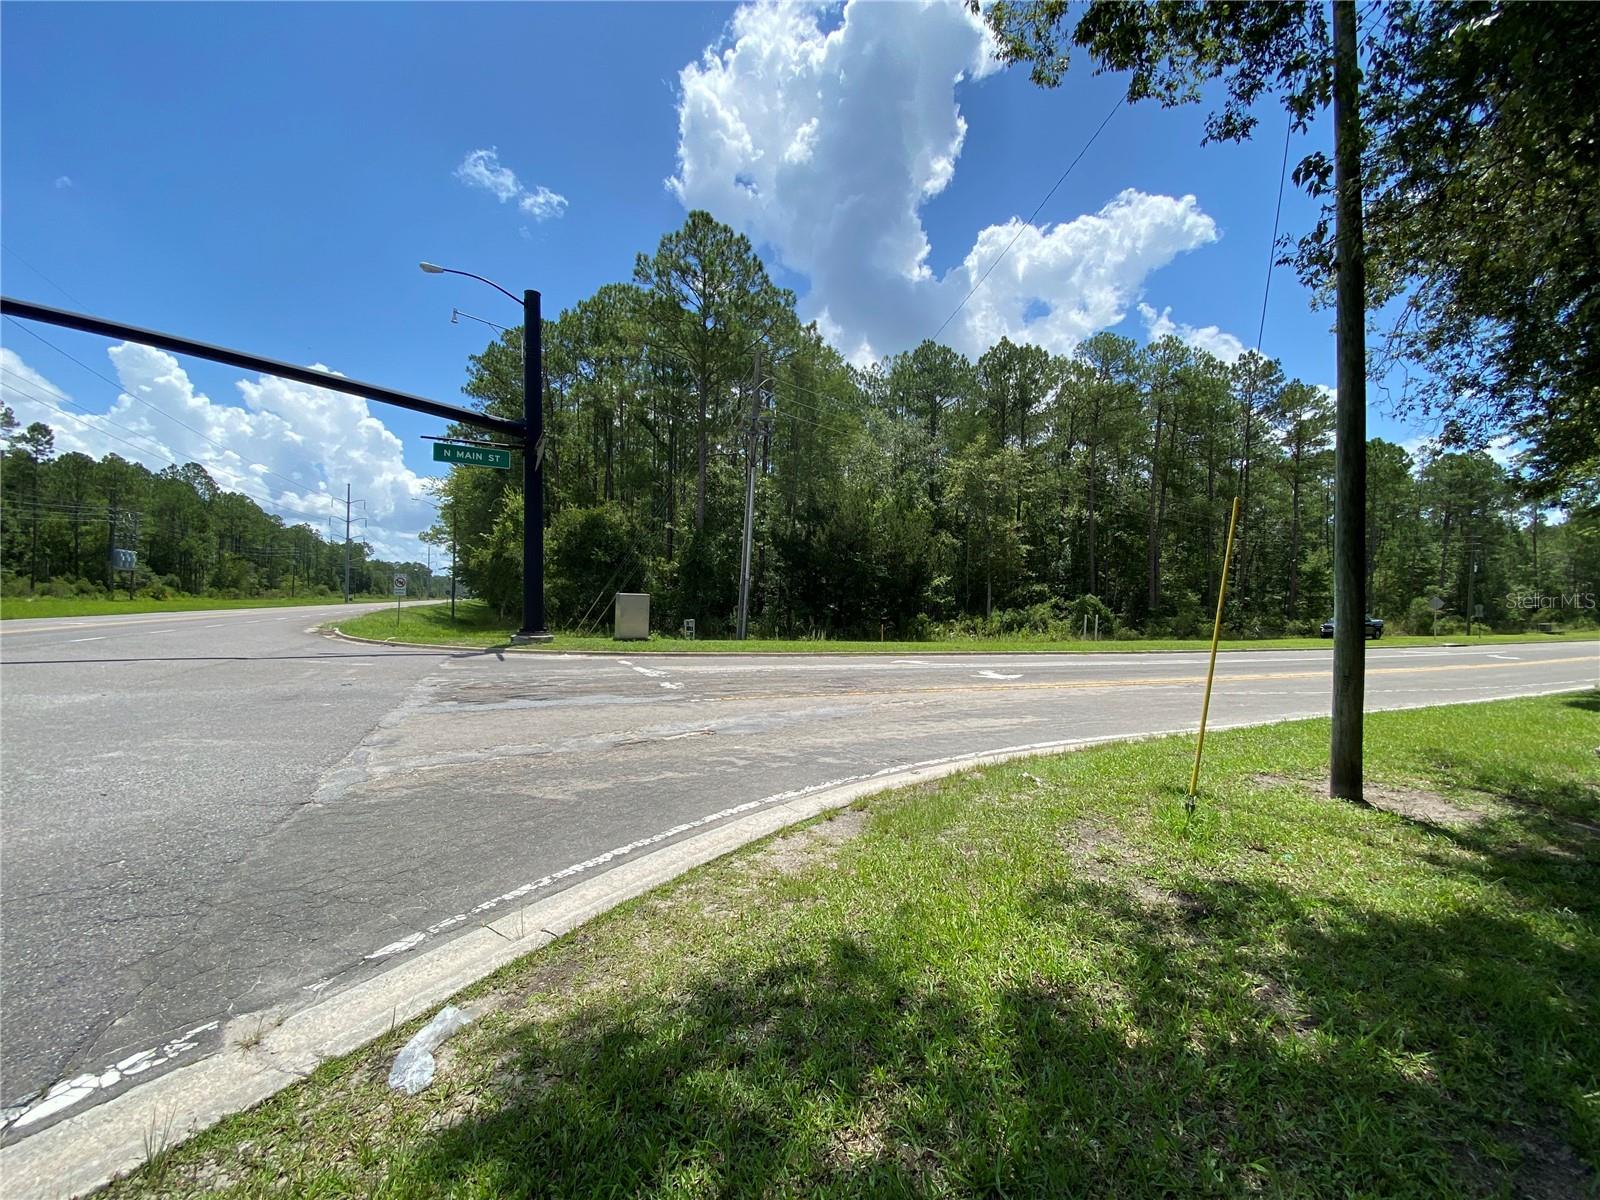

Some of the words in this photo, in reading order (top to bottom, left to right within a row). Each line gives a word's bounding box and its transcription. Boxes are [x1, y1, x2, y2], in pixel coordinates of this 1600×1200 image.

[443, 449, 451, 457] N
[456, 451, 483, 461] MAIN
[488, 454, 501, 463] ST
